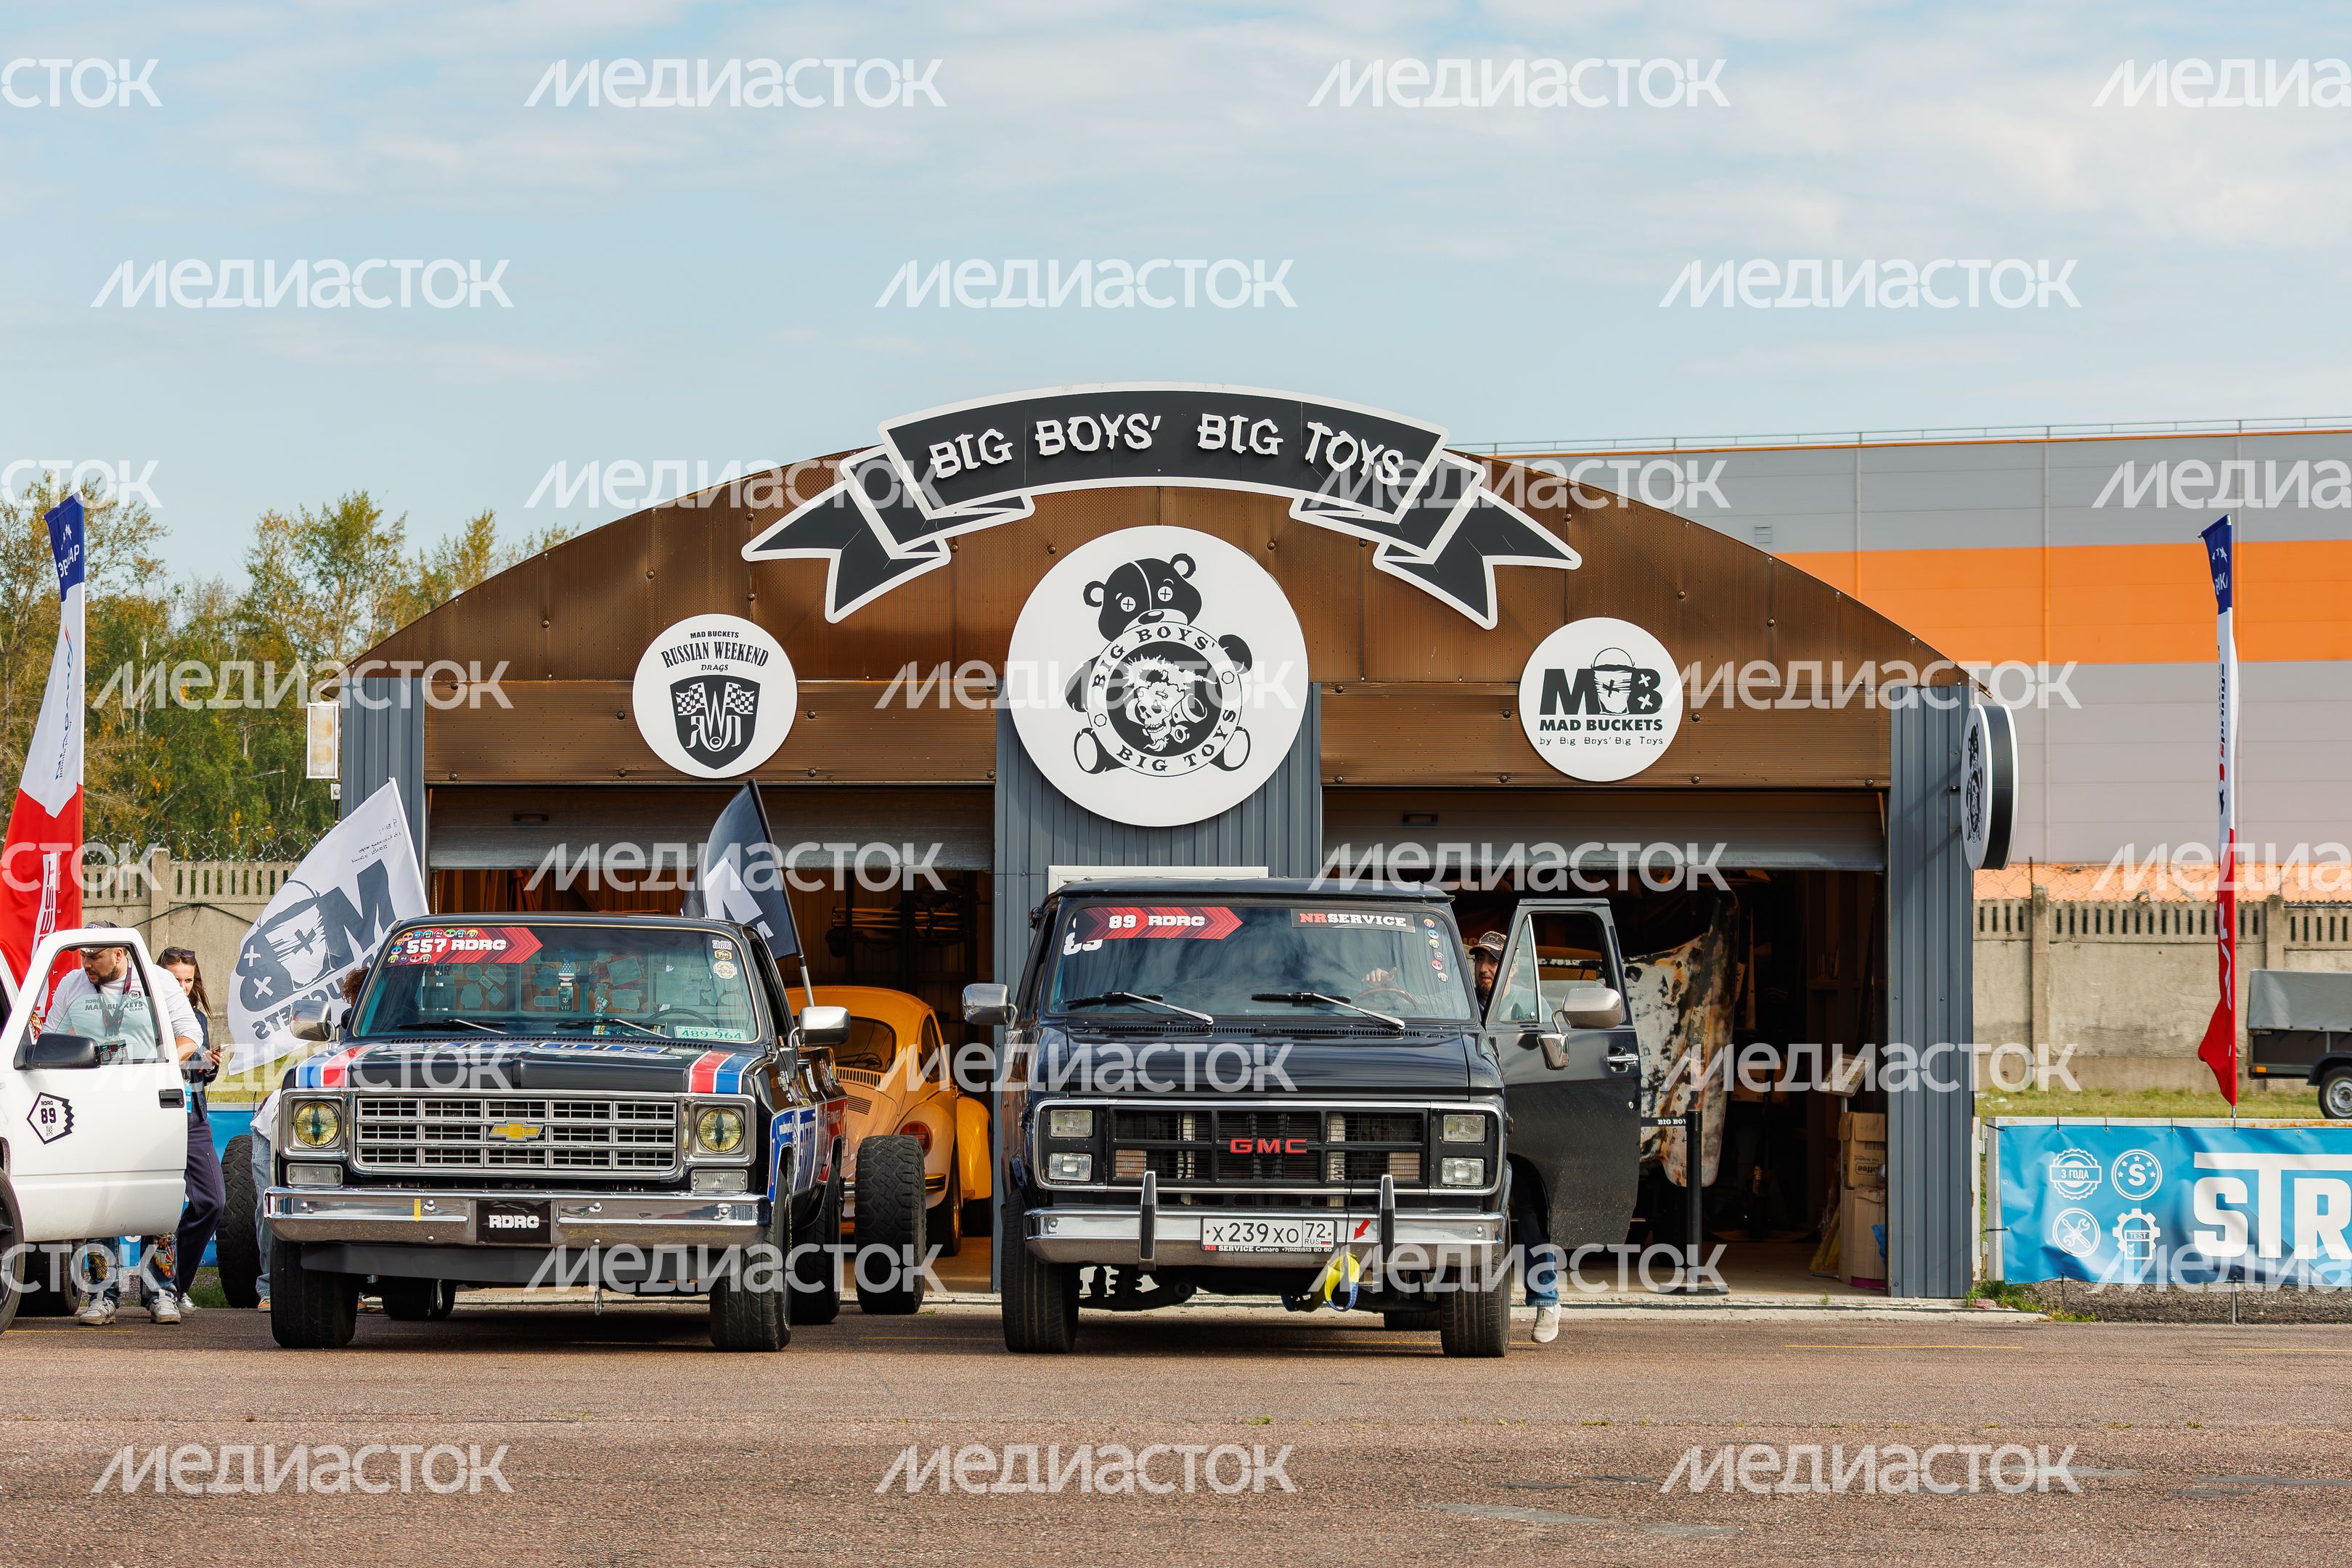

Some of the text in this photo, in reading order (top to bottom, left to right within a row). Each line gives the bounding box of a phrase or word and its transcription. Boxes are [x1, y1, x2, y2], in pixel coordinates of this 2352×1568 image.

[928, 413, 1405, 486] BIG BOYS' BIG TOYS
[707, 630, 739, 639] BUCKETS
[661, 641, 769, 668] RUSSIAN WEEKEND
[1093, 644, 1126, 689] BIG
[1539, 719, 1663, 731] MAD BUCKETS
[1116, 709, 1236, 772] BIG TOYS
[1540, 737, 1552, 746] by
[1560, 737, 1576, 746] Big
[1615, 737, 1631, 746] Big
[1640, 736, 1663, 746] Toys
[1108, 915, 1205, 929] 89 RDRC
[406, 939, 507, 955] 557 RDRC
[682, 1030, 741, 1040] 489-964
[41, 1108, 57, 1124] 89
[1230, 1138, 1307, 1153] GMC
[2061, 1169, 2089, 1180] 3 ГОДА
[489, 1215, 539, 1228] RDRC
[1305, 1222, 1326, 1238] 72
